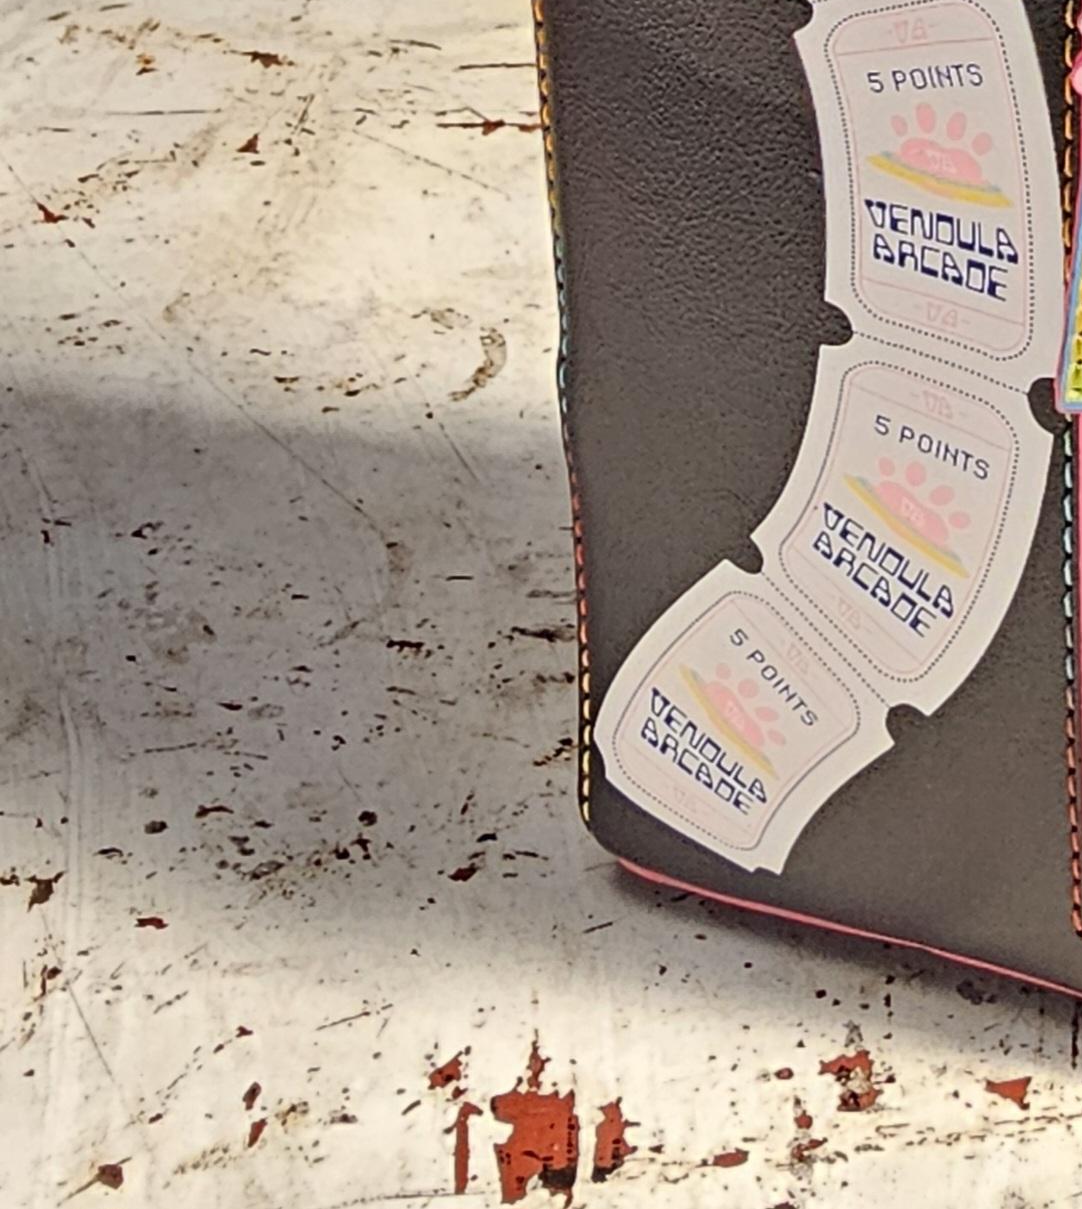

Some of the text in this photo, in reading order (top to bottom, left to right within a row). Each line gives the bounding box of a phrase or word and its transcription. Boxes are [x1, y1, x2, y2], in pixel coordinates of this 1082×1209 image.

[867, 63, 984, 93] 5 POINTS
[864, 199, 1019, 264] VENDULA
[873, 233, 1009, 302] ARCADE
[873, 414, 990, 481] 5 POINTS
[812, 531, 938, 638] ARCADE
[823, 502, 954, 619] VENDULA
[729, 628, 819, 727] 5 POINTS
[640, 717, 754, 816] ARCADE
[651, 687, 768, 804] VENDULA
